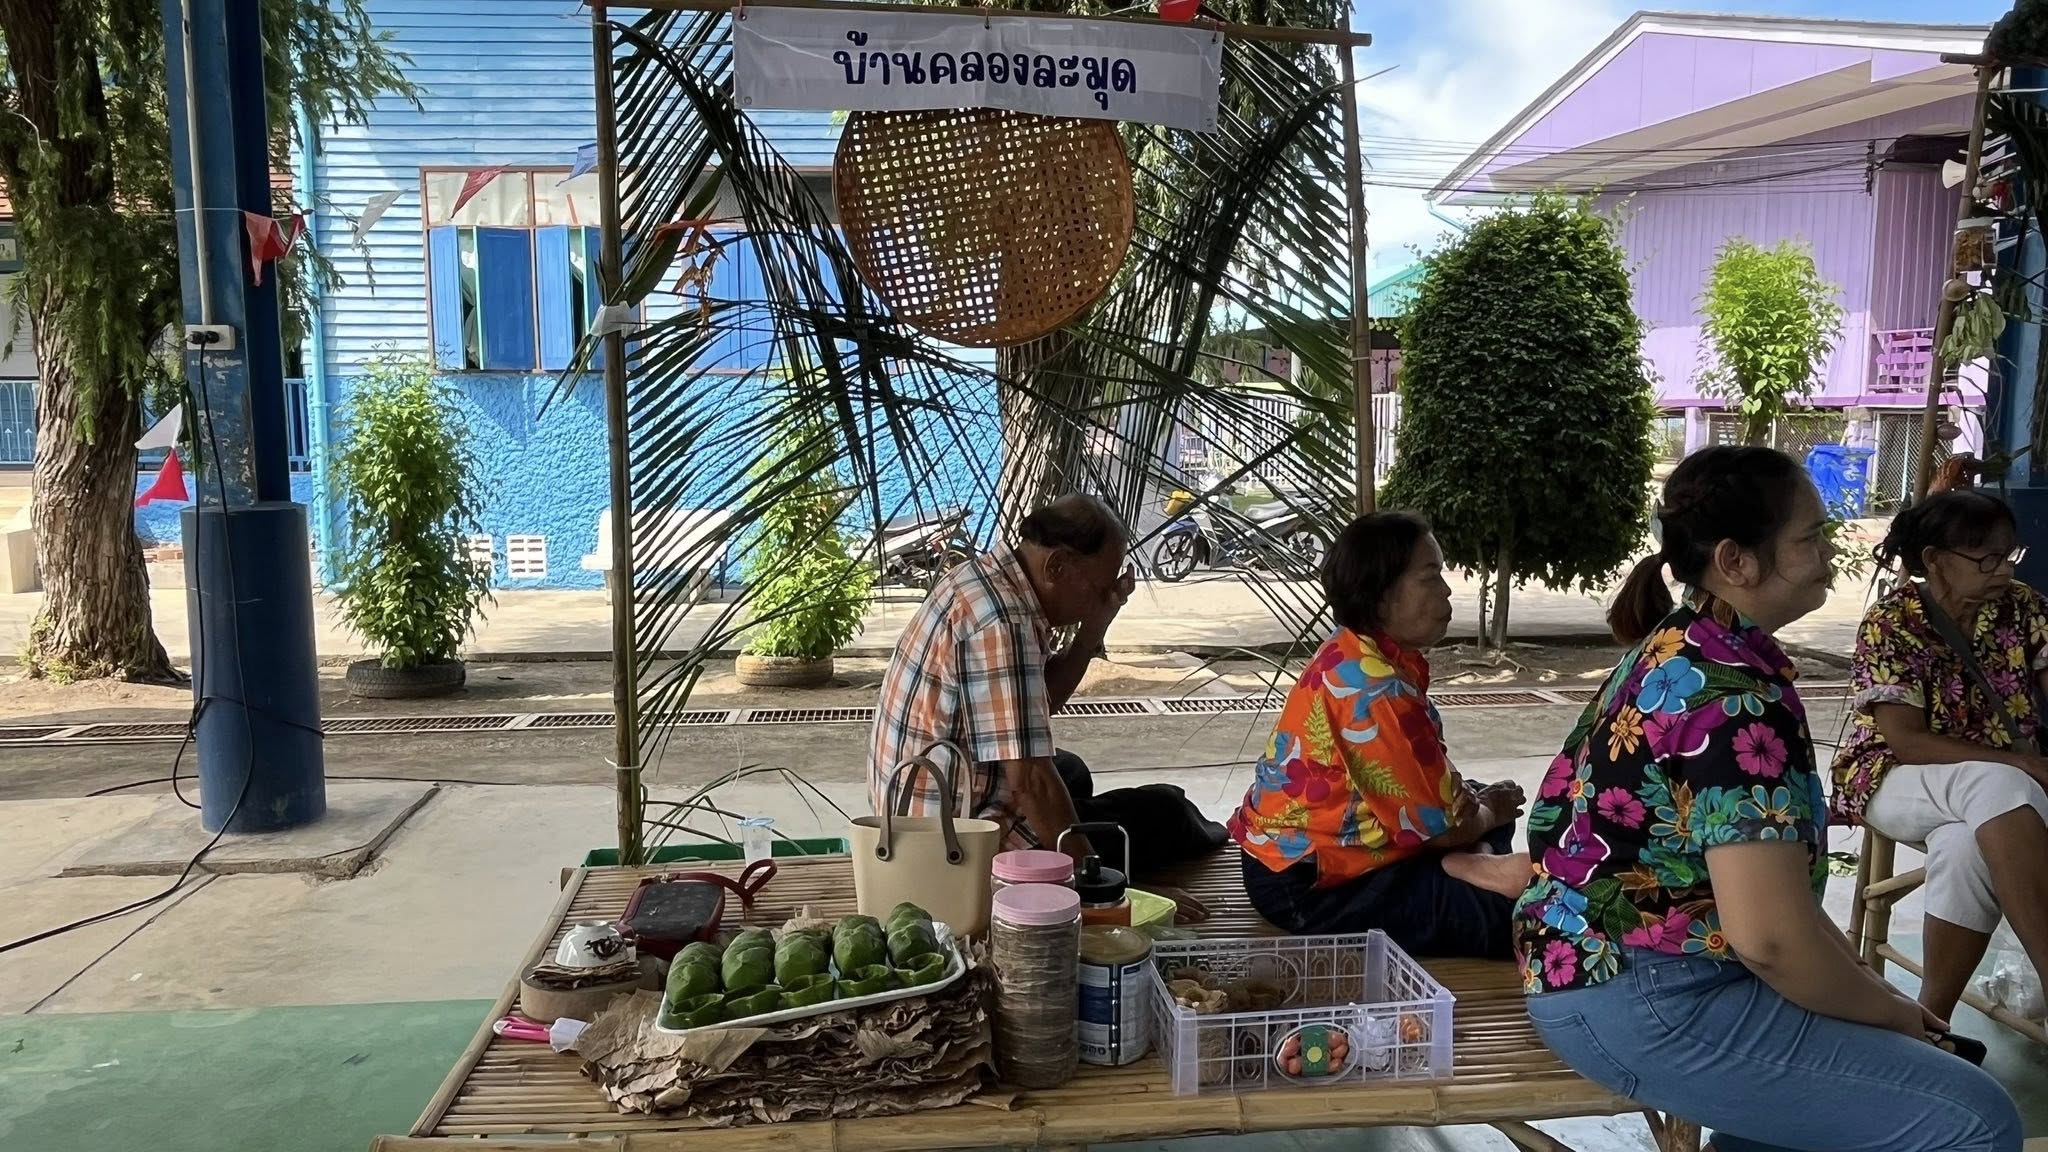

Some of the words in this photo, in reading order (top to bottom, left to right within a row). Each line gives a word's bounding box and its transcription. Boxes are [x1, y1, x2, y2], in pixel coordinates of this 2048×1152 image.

[833, 30, 1136, 110] บ้านคลองละมุด
